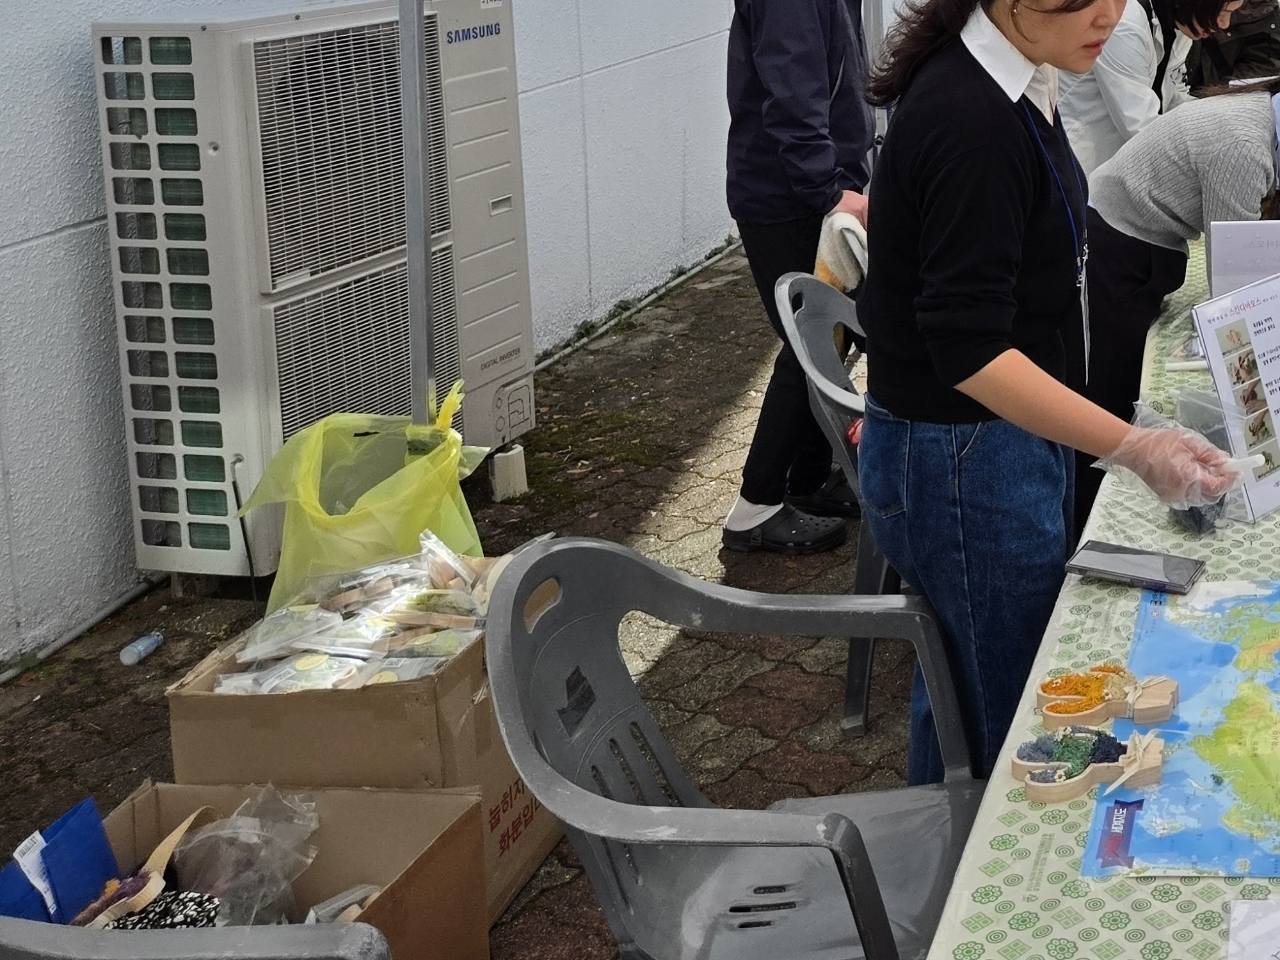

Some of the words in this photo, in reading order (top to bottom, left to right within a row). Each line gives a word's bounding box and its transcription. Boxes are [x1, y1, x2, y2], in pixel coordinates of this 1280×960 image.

[446, 22, 501, 44] SAMSUNG
[480, 358, 499, 371] DIGITAL
[499, 347, 521, 362] INVERTER
